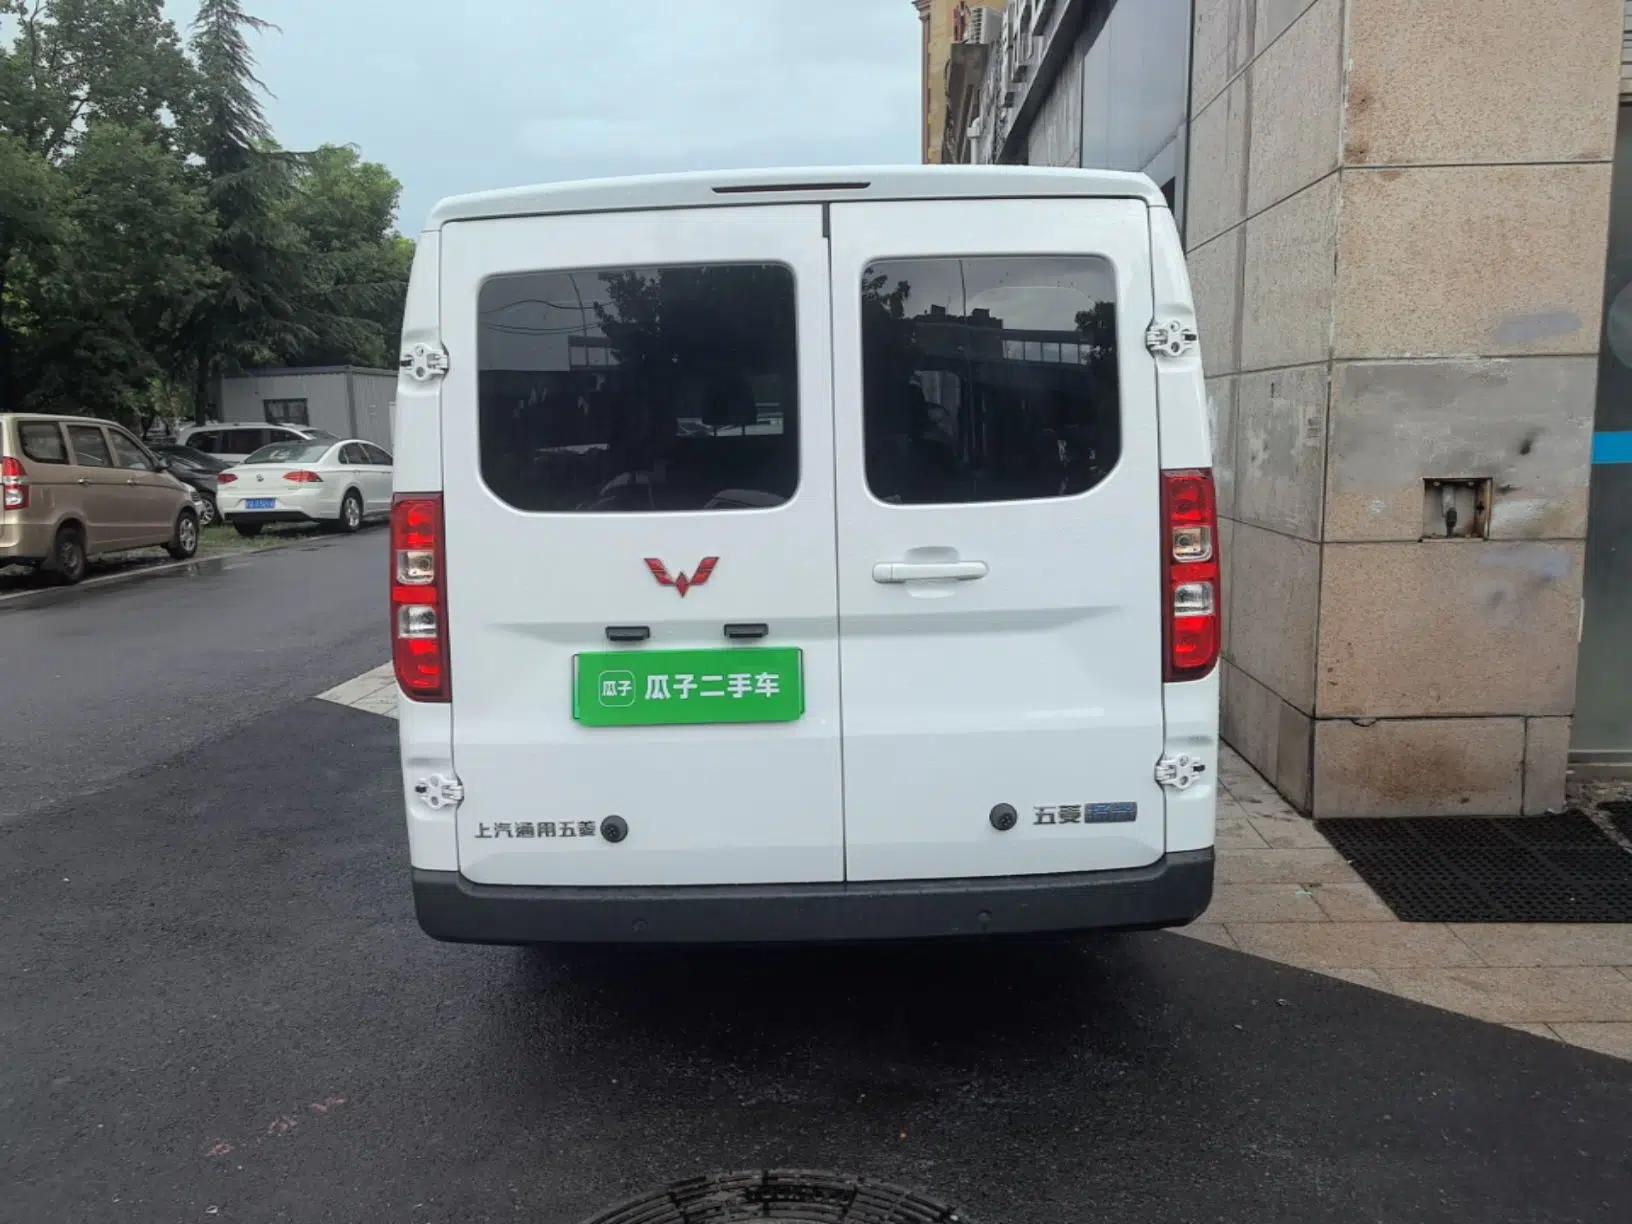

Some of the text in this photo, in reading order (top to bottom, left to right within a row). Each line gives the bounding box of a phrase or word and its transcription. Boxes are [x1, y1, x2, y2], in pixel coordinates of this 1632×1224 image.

[602, 671, 780, 700] 瓜子 瓜子二手车
[1033, 804, 1082, 825] 五菱
[475, 820, 596, 838] 上汽通用五菱
